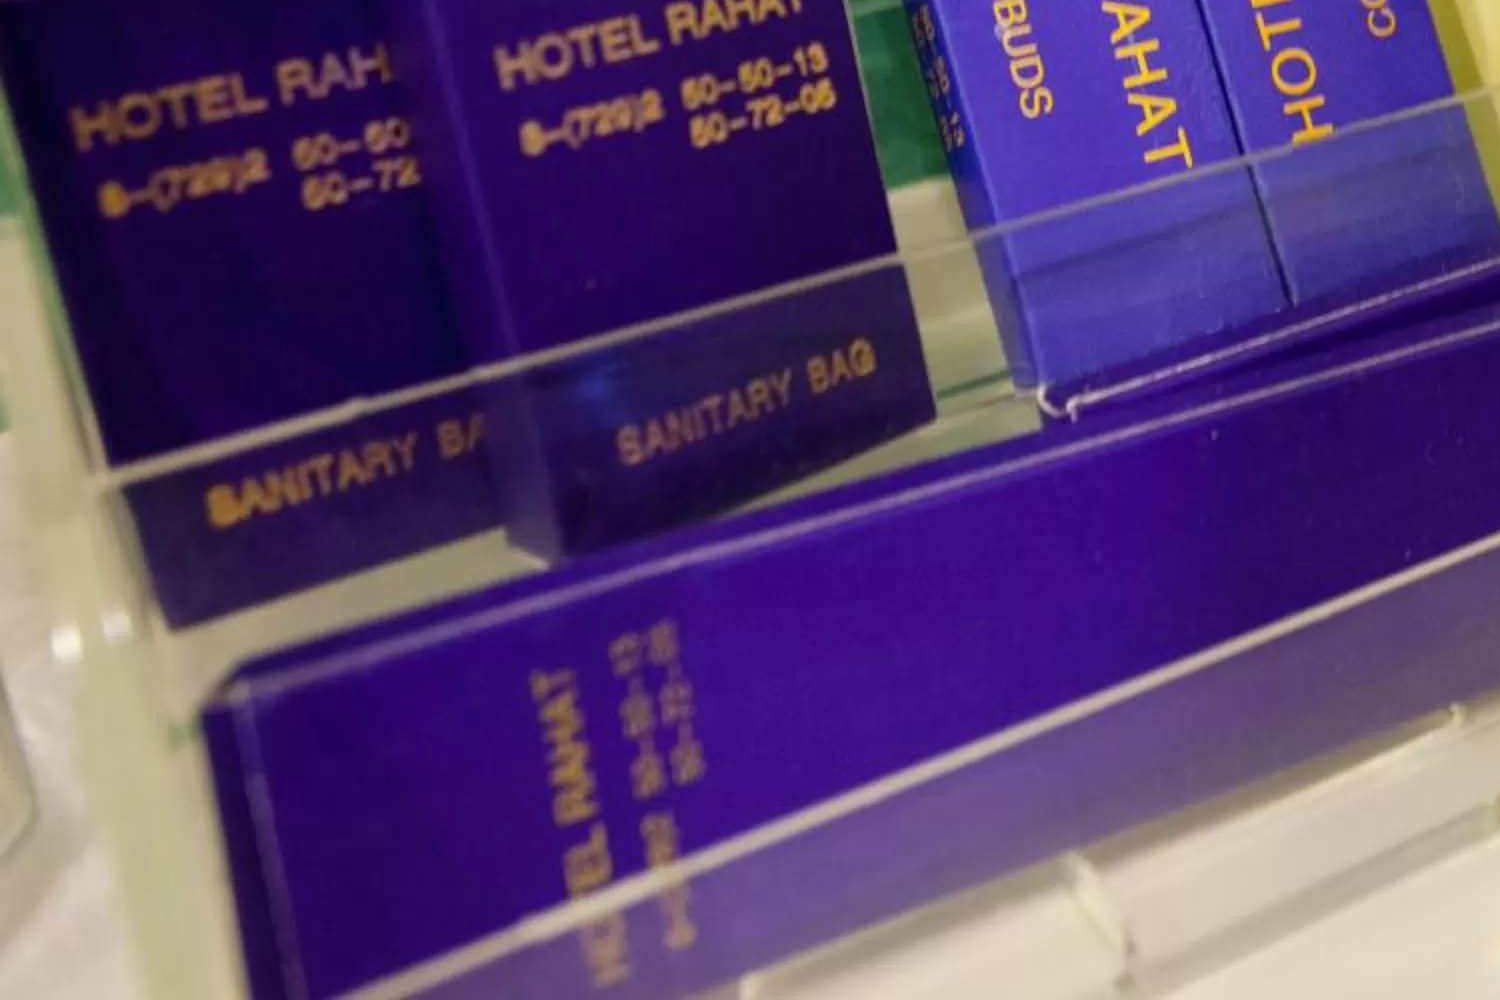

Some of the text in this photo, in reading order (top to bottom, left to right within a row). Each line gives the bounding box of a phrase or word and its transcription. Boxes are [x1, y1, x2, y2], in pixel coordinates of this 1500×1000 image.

[72, 43, 393, 149] HOTEL RAH
[494, 14, 658, 90] HOTEL
[617, 337, 877, 466] SANITARY BAG
[206, 430, 419, 528] SANITARY
